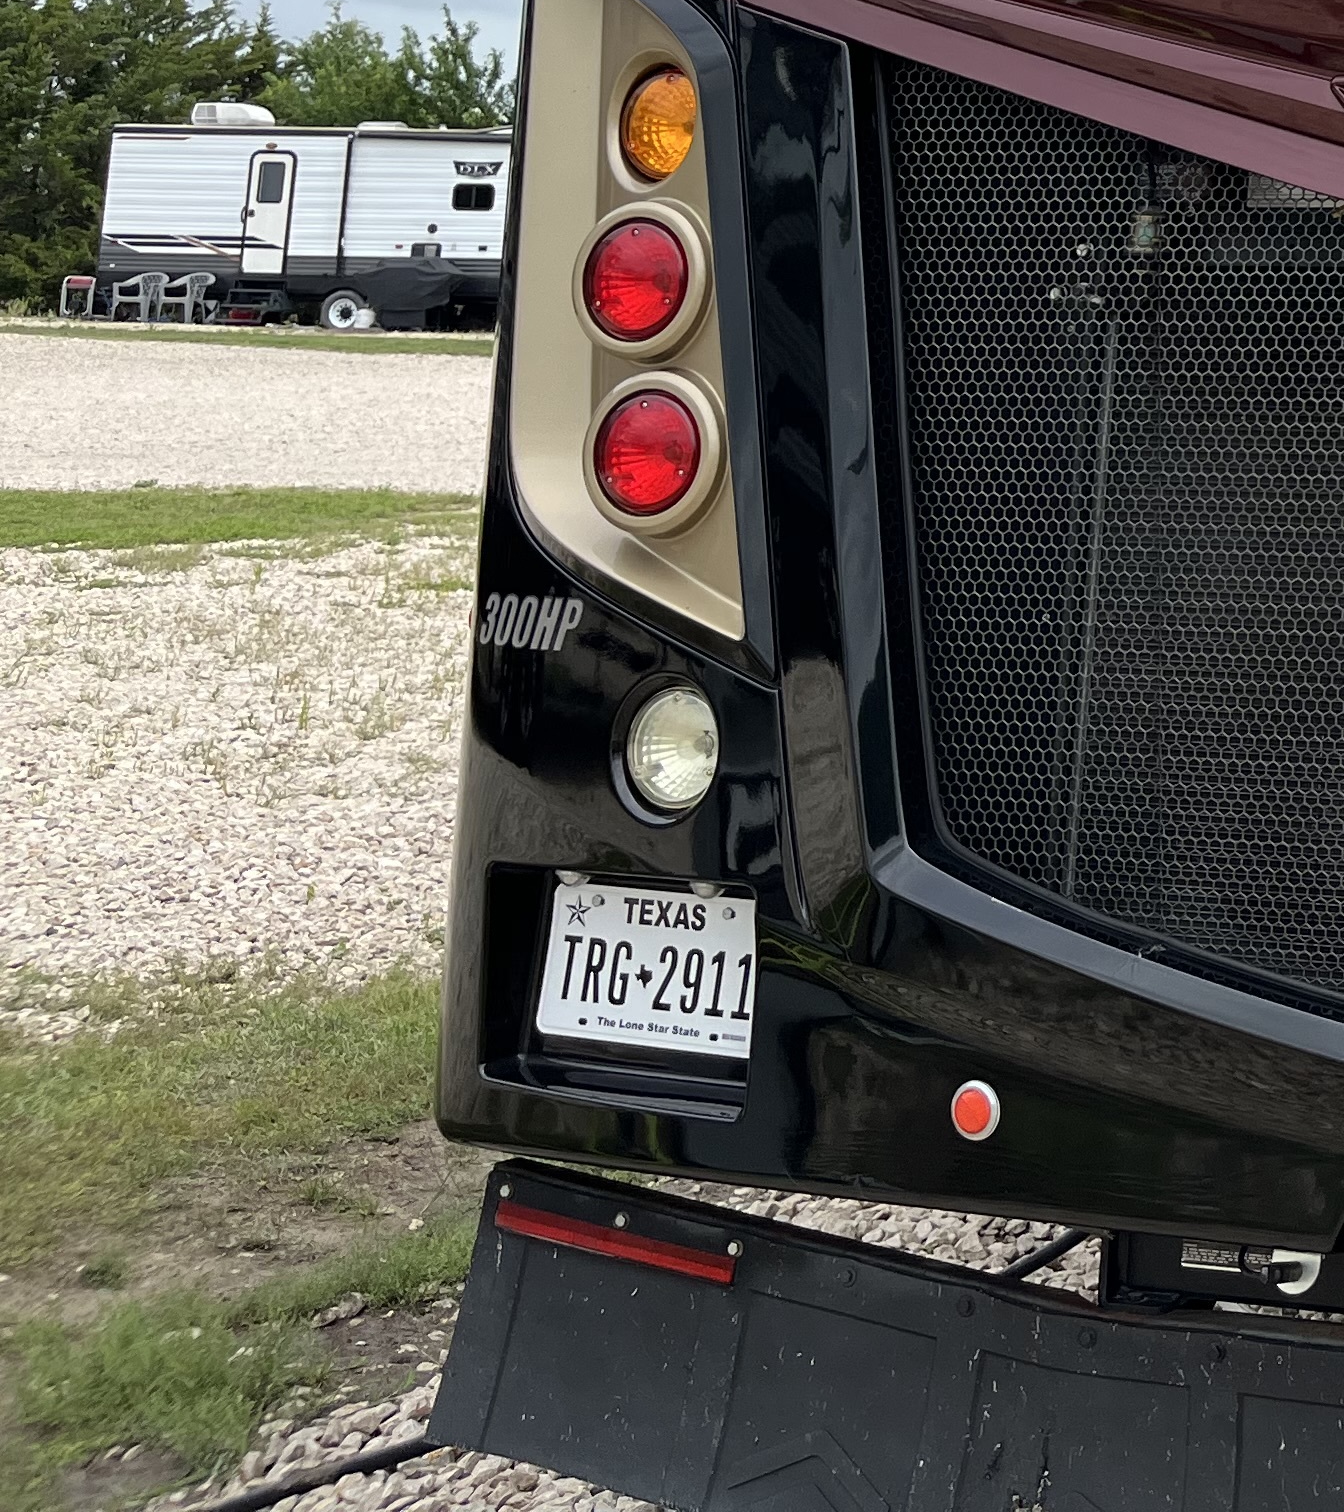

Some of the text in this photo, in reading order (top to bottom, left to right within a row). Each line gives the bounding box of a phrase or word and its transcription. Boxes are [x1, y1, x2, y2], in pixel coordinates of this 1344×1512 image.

[460, 164, 496, 176] DLX
[479, 592, 584, 652] 300HP
[623, 896, 707, 931] TEXAS
[561, 935, 753, 1021] TRG 2911
[597, 1016, 700, 1038] The Lone Star State
